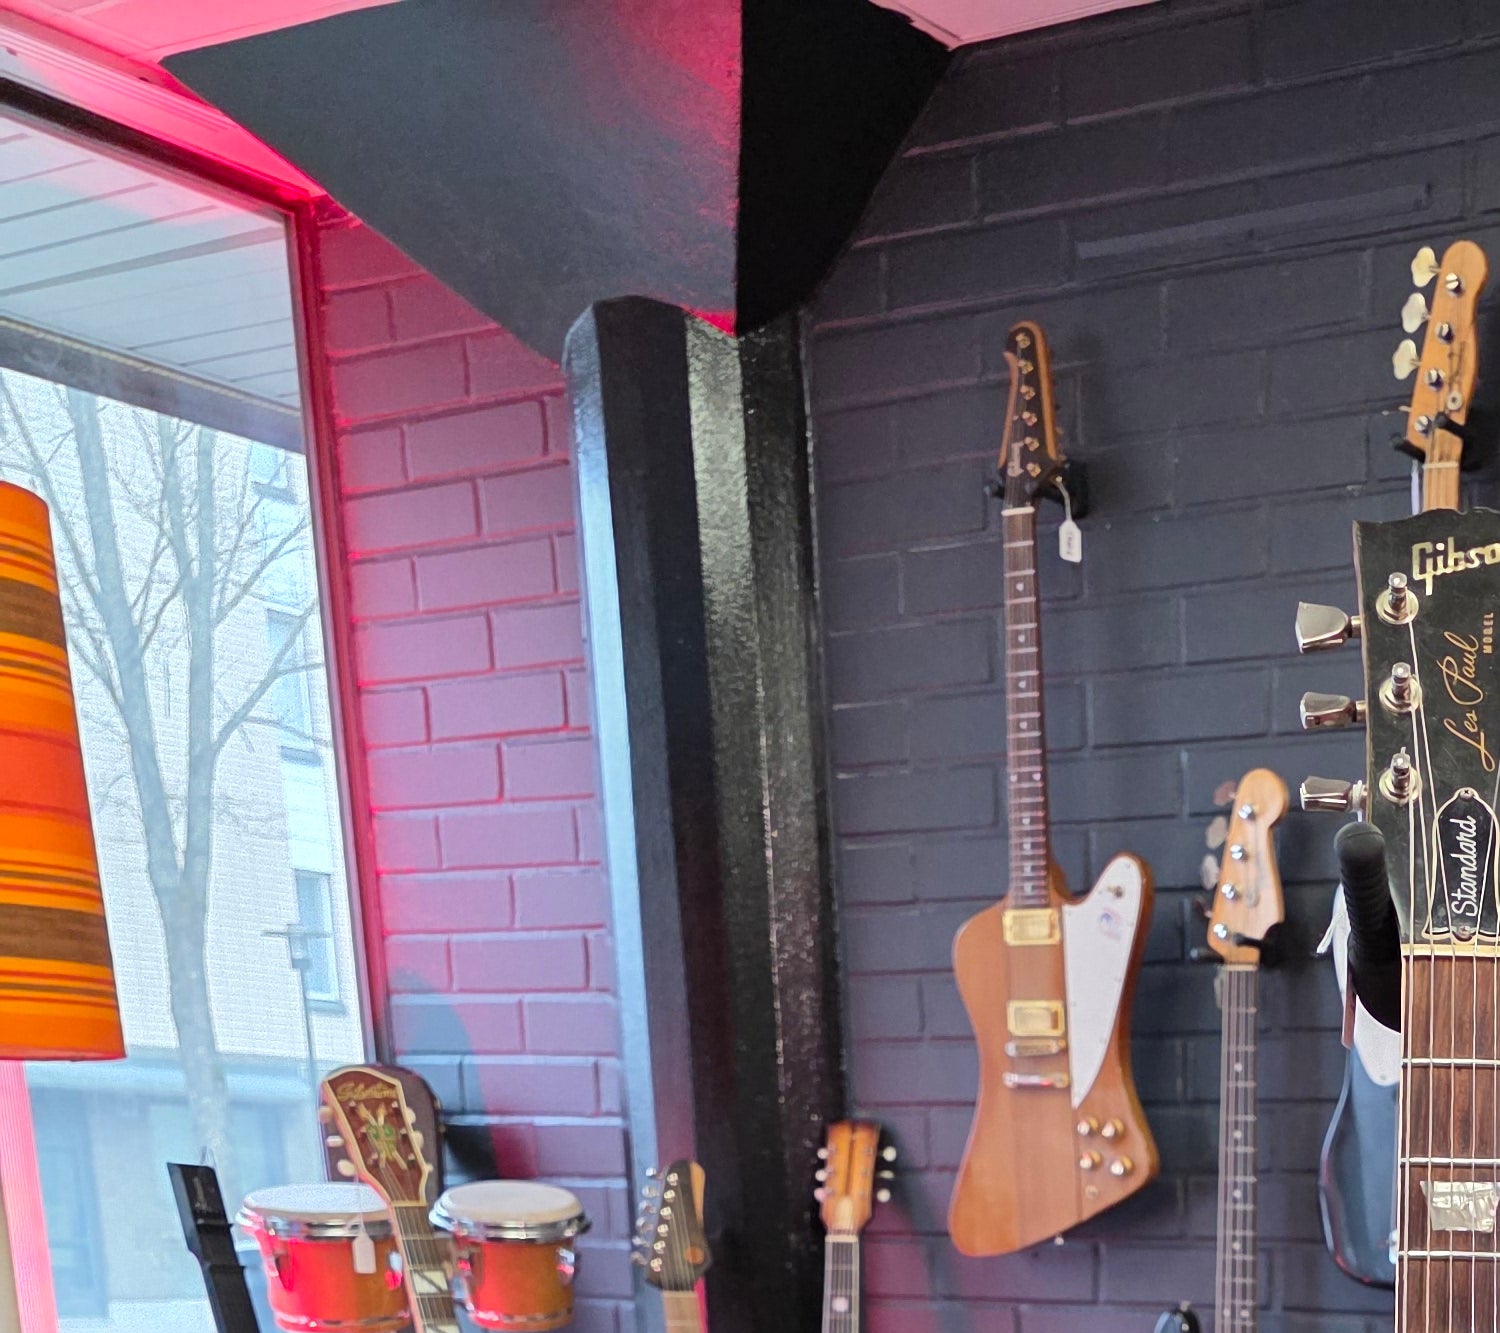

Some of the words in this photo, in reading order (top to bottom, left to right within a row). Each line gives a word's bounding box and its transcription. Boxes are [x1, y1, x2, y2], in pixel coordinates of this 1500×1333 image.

[1482, 612, 1494, 654] MODEL
[1438, 633, 1485, 707] Paul
[1443, 707, 1497, 773] Les
[1451, 815, 1479, 918] Standard
